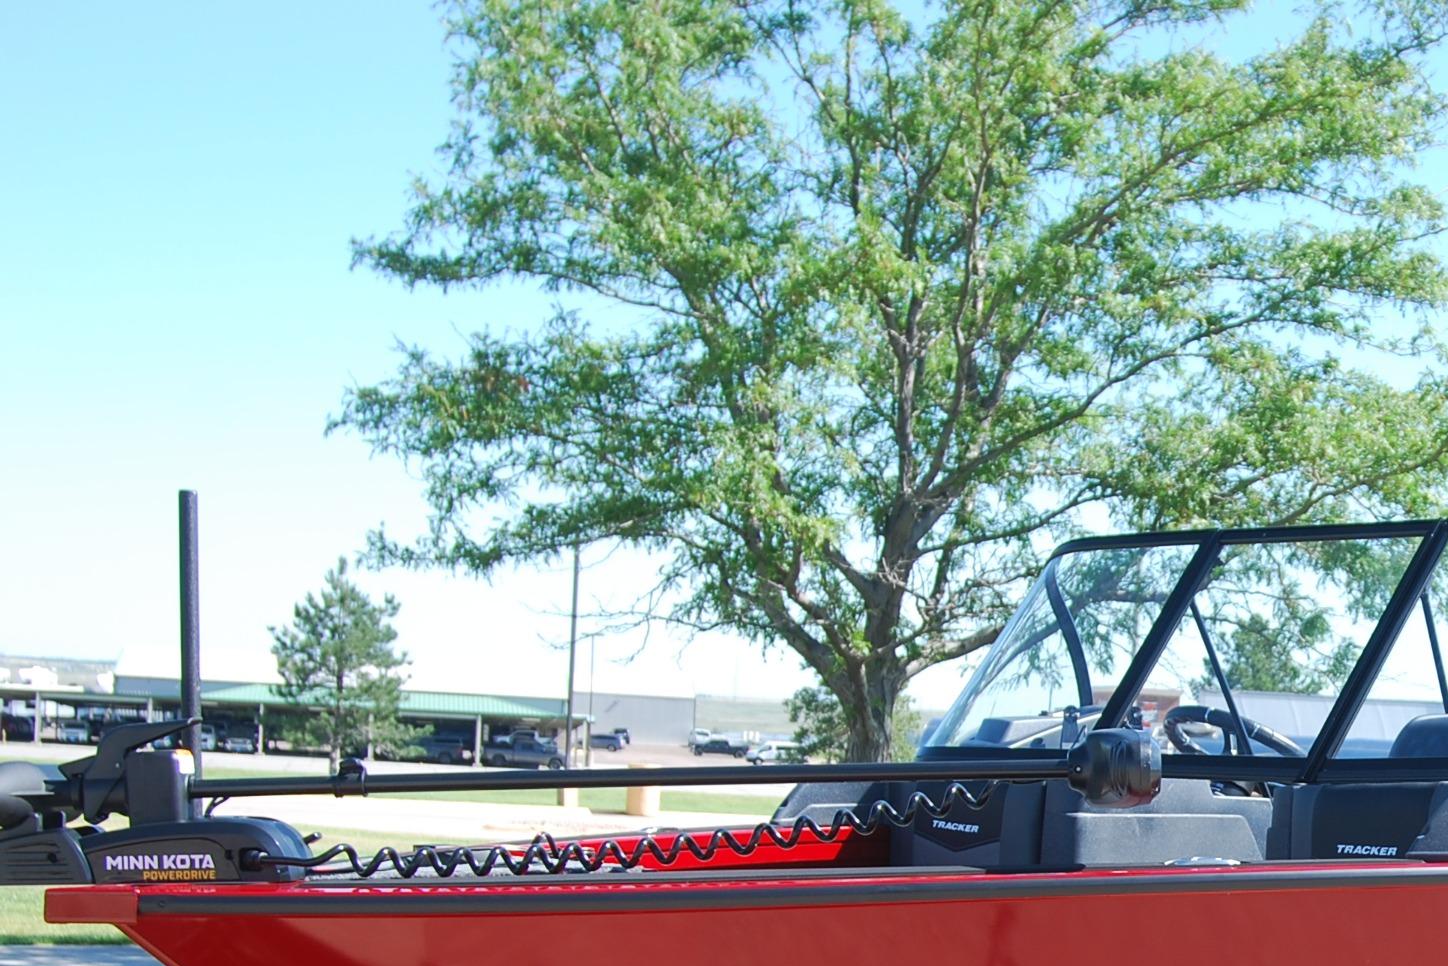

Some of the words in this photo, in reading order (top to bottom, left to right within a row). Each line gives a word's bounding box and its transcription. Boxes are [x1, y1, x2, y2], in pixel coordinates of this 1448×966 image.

[932, 819, 980, 833] TRACKER
[1336, 844, 1398, 856] TRACKER
[105, 855, 159, 870] MINN
[162, 854, 215, 869] KOTA
[143, 870, 216, 880] POWERDRIVE
